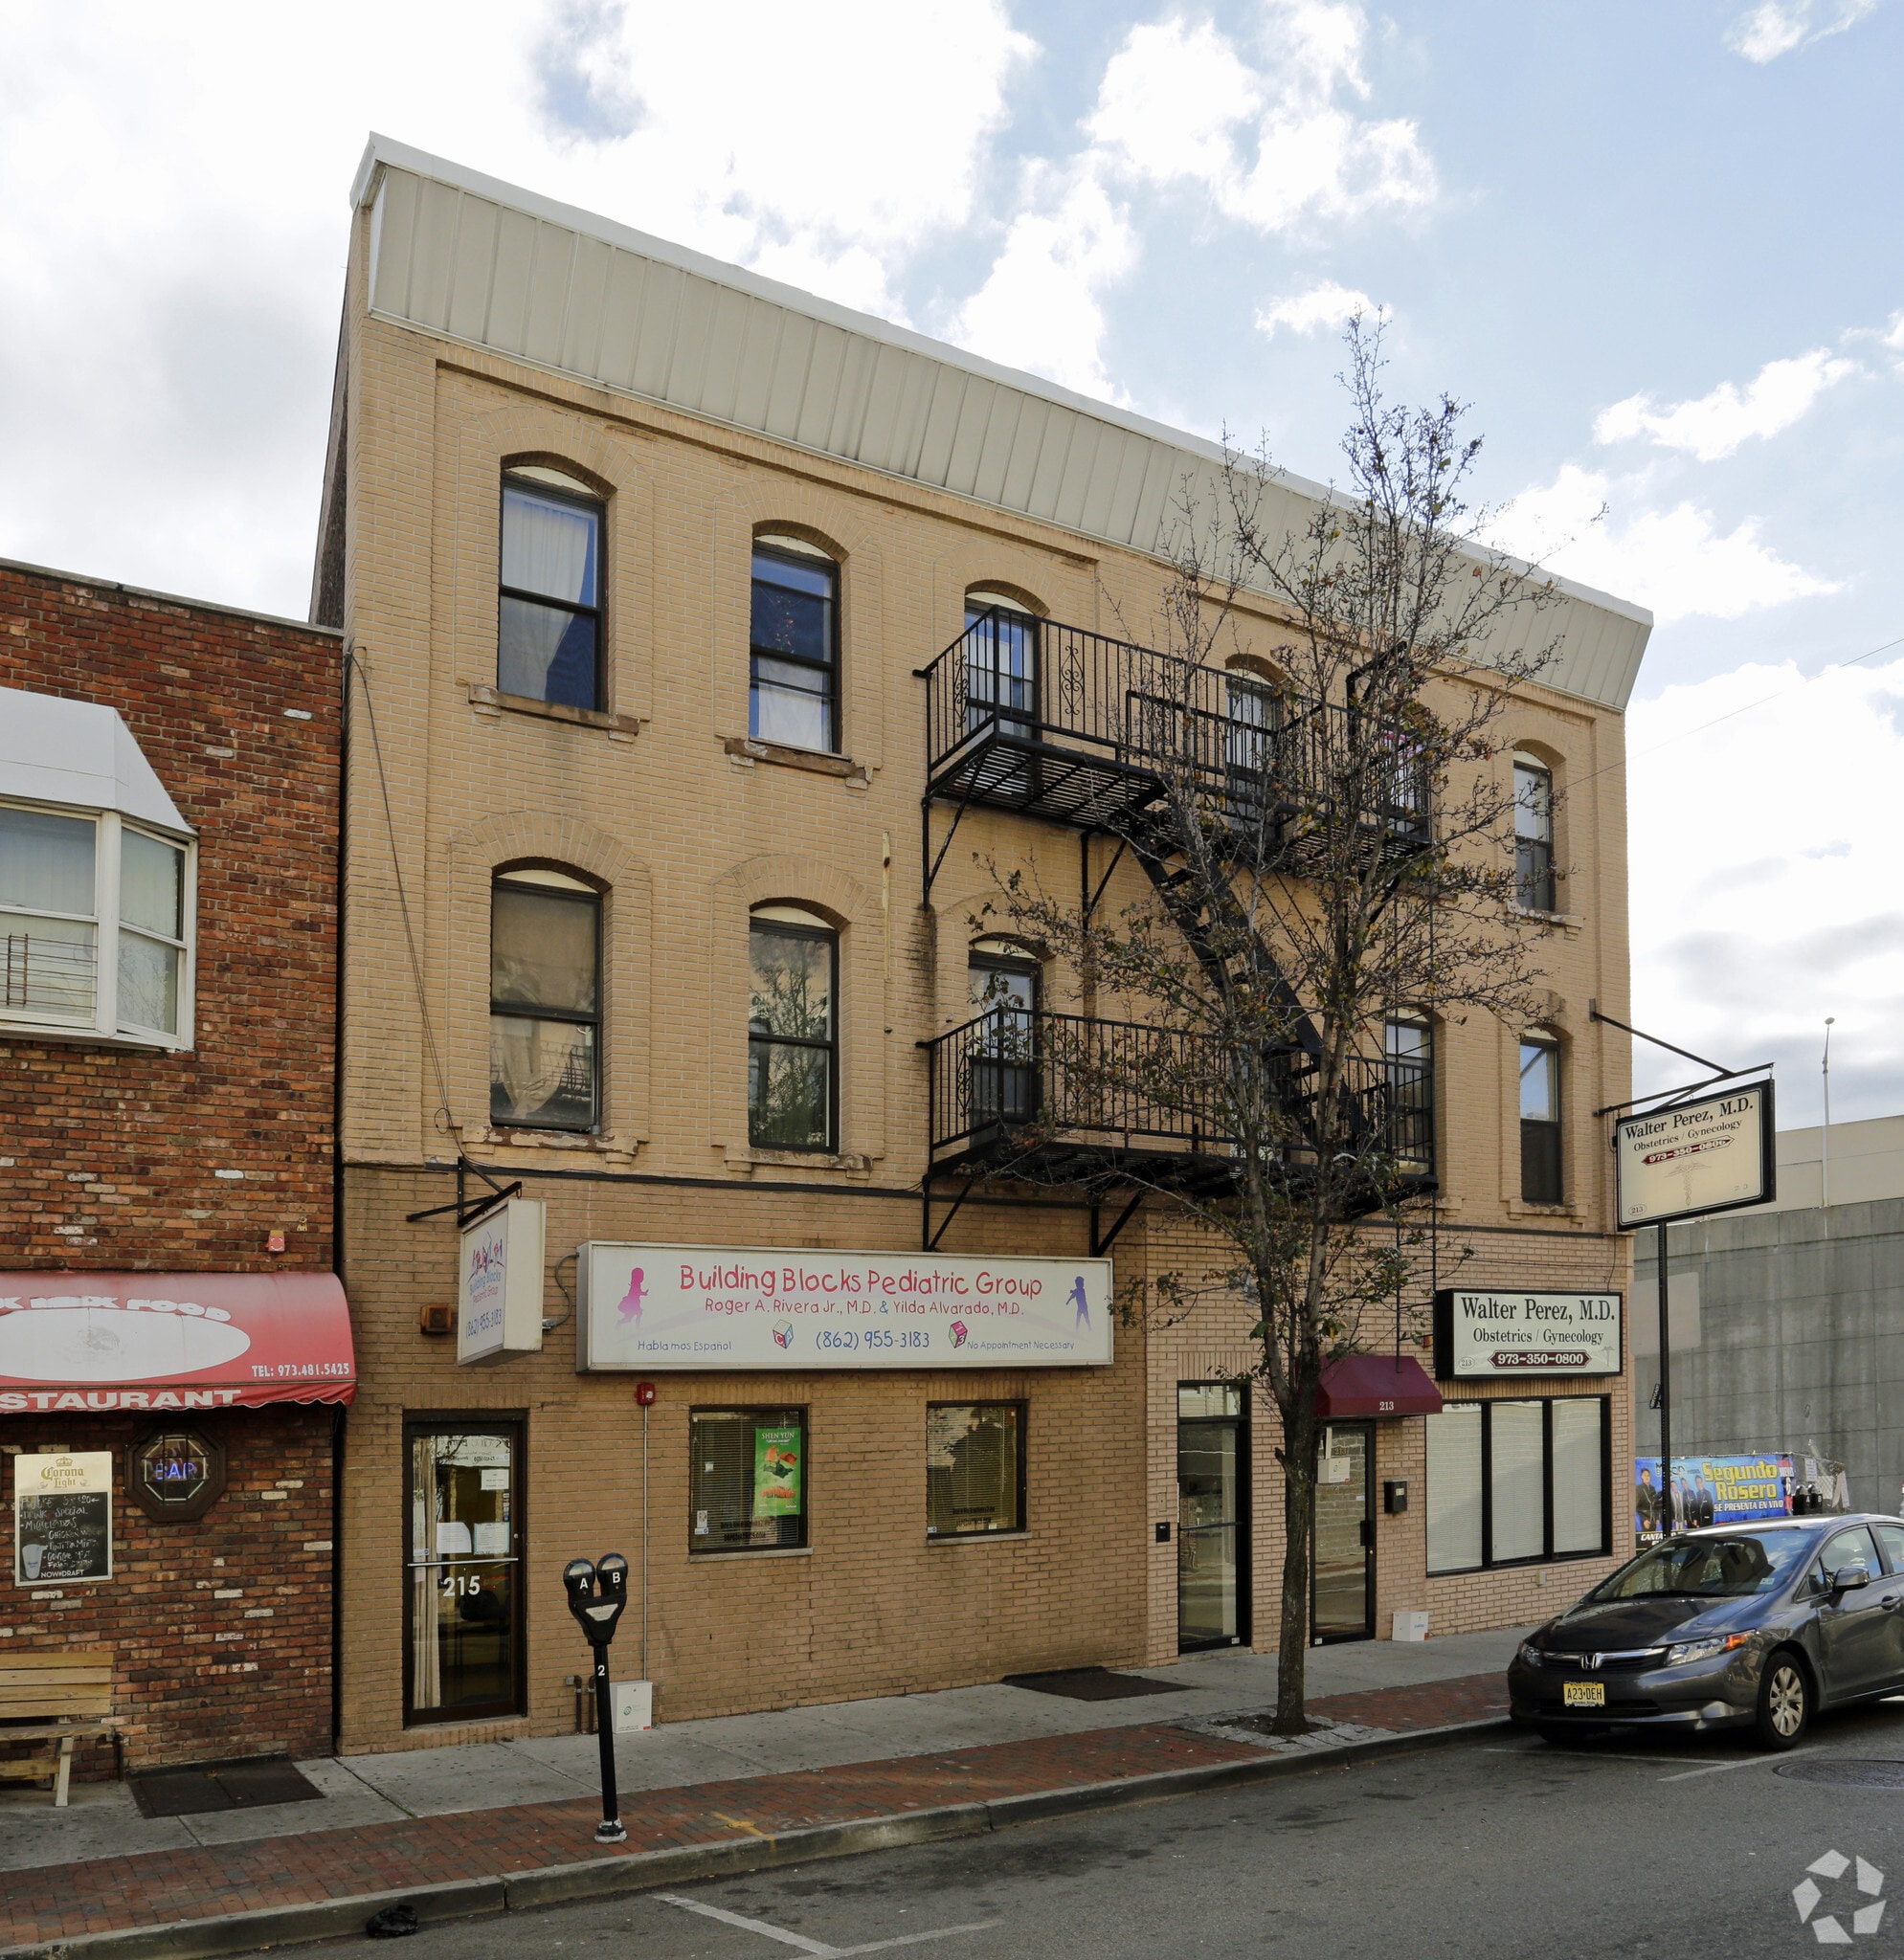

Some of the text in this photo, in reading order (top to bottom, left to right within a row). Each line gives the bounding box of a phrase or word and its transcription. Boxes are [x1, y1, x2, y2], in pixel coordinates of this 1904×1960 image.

[1625, 1097, 1754, 1140] Walter Perez, M.D.
[1633, 1135, 1679, 1152] Obstetrics
[1688, 1120, 1742, 1139] Gynecology
[680, 1264, 1042, 1301] Building Blocks Pediatric Group
[126, 1298, 233, 1322] FOOD
[705, 1298, 1024, 1316] Roger A. Rivera Jr., M.D. & Yilda Alvarado, M.D.
[1461, 1297, 1616, 1325] Walter Perez, M.D.
[816, 1330, 860, 1350] (862)
[863, 1330, 930, 1349] 955-3183
[1473, 1327, 1532, 1343] Obstetrics
[1543, 1328, 1604, 1346] Gynecology
[693, 1340, 732, 1352] Español
[967, 1341, 1075, 1351] No Appointment Necessary
[1461, 1358, 1473, 1367] 213
[1497, 1352, 1584, 1365] 973-350-0800
[251, 1362, 350, 1378] TEL: 973.481.5425
[0, 1390, 241, 1410] STAURANT
[1378, 1401, 1395, 1411] 213
[40, 1466, 84, 1481] Corona
[1701, 1460, 1779, 1484] Segundo
[54, 1478, 77, 1489] Light
[1715, 1482, 1778, 1502] Rosero
[1714, 1499, 1783, 1512] SE PRESENTA EN VIVO
[61, 1569, 85, 1577] DRAFT
[579, 1571, 621, 1590] A B
[442, 1575, 481, 1596] 215
[597, 1664, 606, 1677] 2
